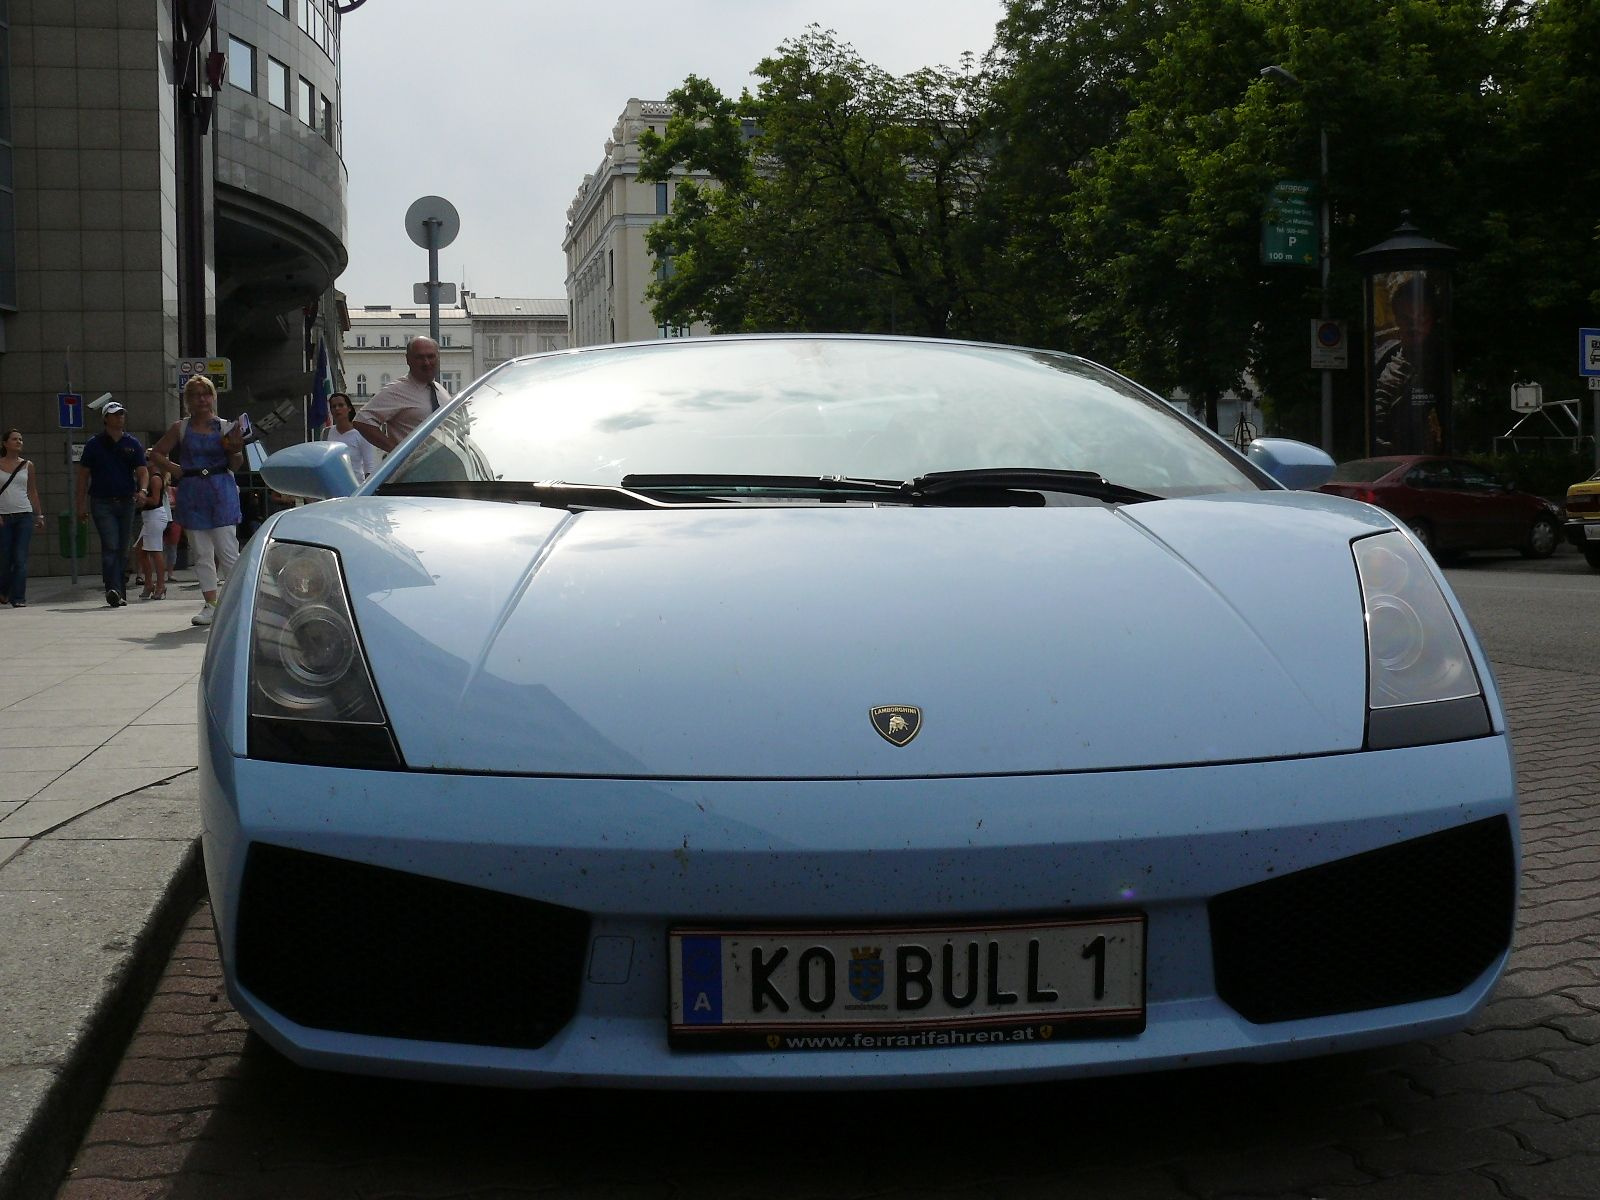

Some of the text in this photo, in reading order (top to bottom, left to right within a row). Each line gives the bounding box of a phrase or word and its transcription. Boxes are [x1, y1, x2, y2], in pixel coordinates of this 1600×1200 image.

[1288, 236, 1297, 247] P
[1268, 252, 1284, 260] 100
[874, 706, 917, 715] LAMBORGHINI
[752, 935, 1106, 1012] KO BULL 1
[693, 992, 712, 1012] A
[785, 1027, 1035, 1049] www.ferrarifahren.at
